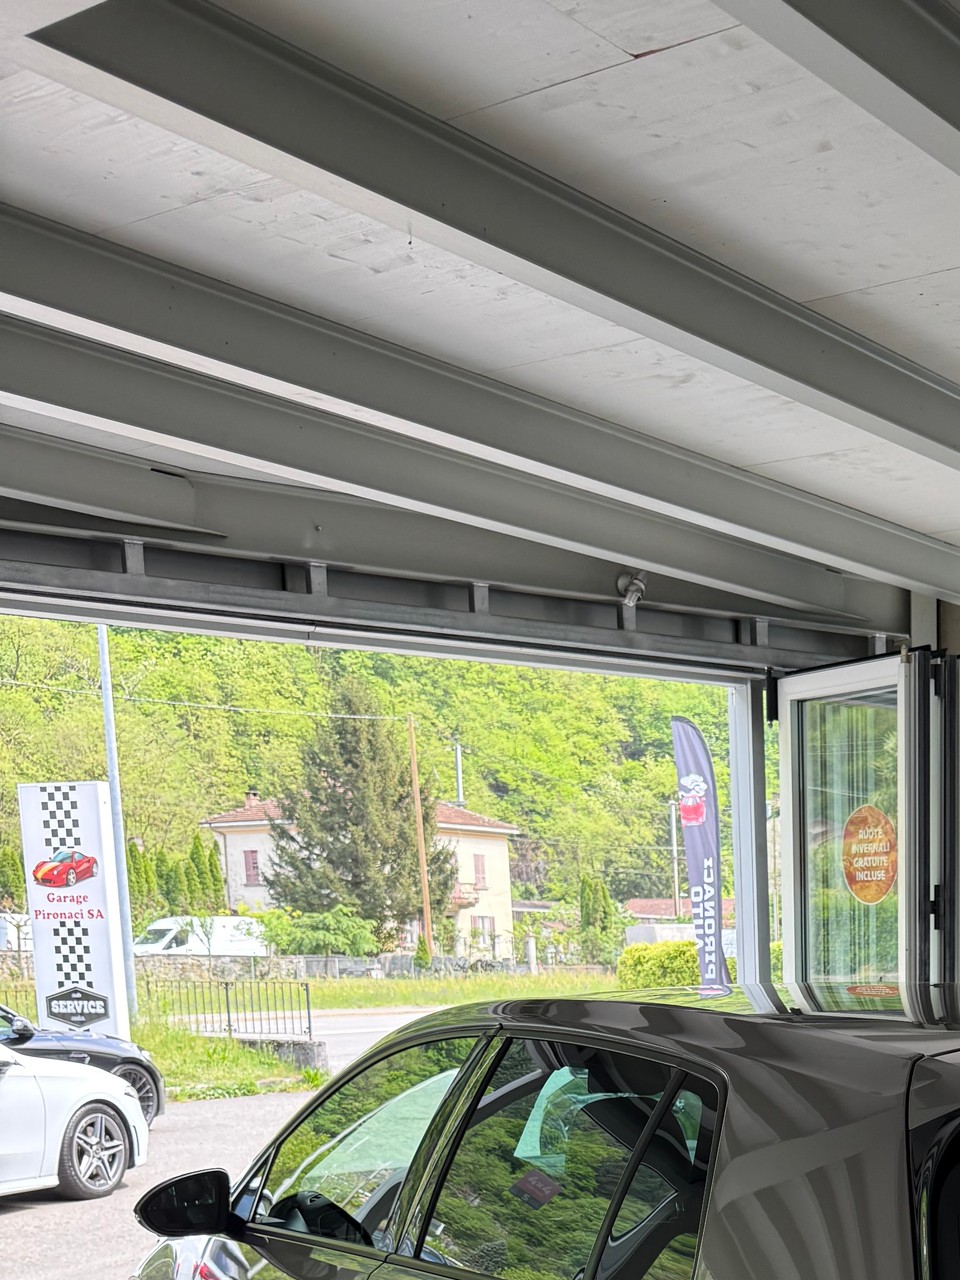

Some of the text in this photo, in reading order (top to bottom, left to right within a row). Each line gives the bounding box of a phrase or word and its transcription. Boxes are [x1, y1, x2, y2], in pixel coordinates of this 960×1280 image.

[858, 829, 882, 839] RUOTE
[851, 841, 890, 854] INVERNALI
[853, 856, 888, 867] GRATUITE
[855, 870, 886, 881] INCLUSE
[46, 892, 89, 906] Garage
[34, 908, 105, 920] Pironaci SA
[51, 1000, 105, 1014] SERVICE
